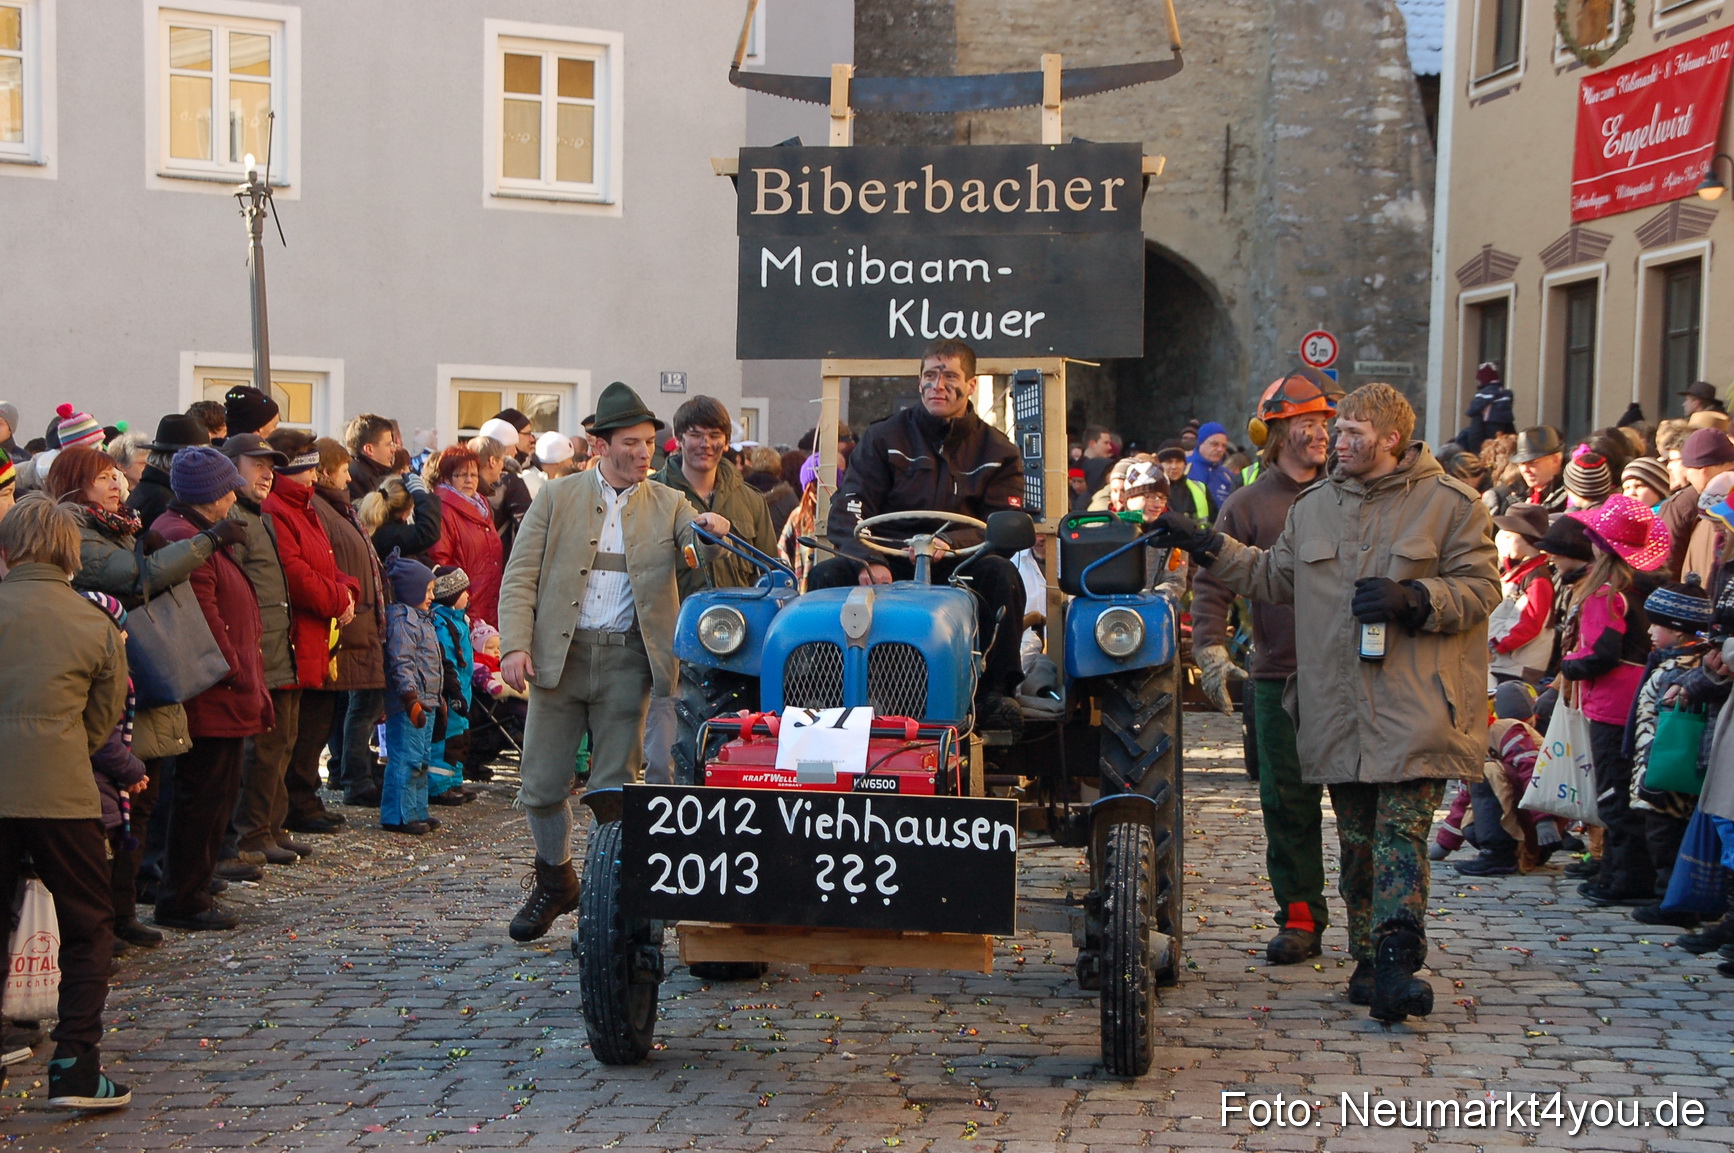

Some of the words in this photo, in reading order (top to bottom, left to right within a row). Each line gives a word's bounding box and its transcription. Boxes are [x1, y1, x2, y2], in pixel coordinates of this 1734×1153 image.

[1707, 41, 1731, 65] 2012
[1602, 102, 1695, 167] Engelwirt
[751, 163, 1125, 215] Biberbacher
[760, 245, 1013, 288] Maibaam-
[889, 298, 1046, 339] Klauer
[1310, 341, 1318, 357] 3
[1318, 349, 1328, 357] m
[667, 373, 682, 385] 12
[647, 795, 762, 835] 2012
[778, 797, 1017, 852] Viehhausen
[647, 852, 759, 895] 2013
[815, 854, 899, 905] ???
